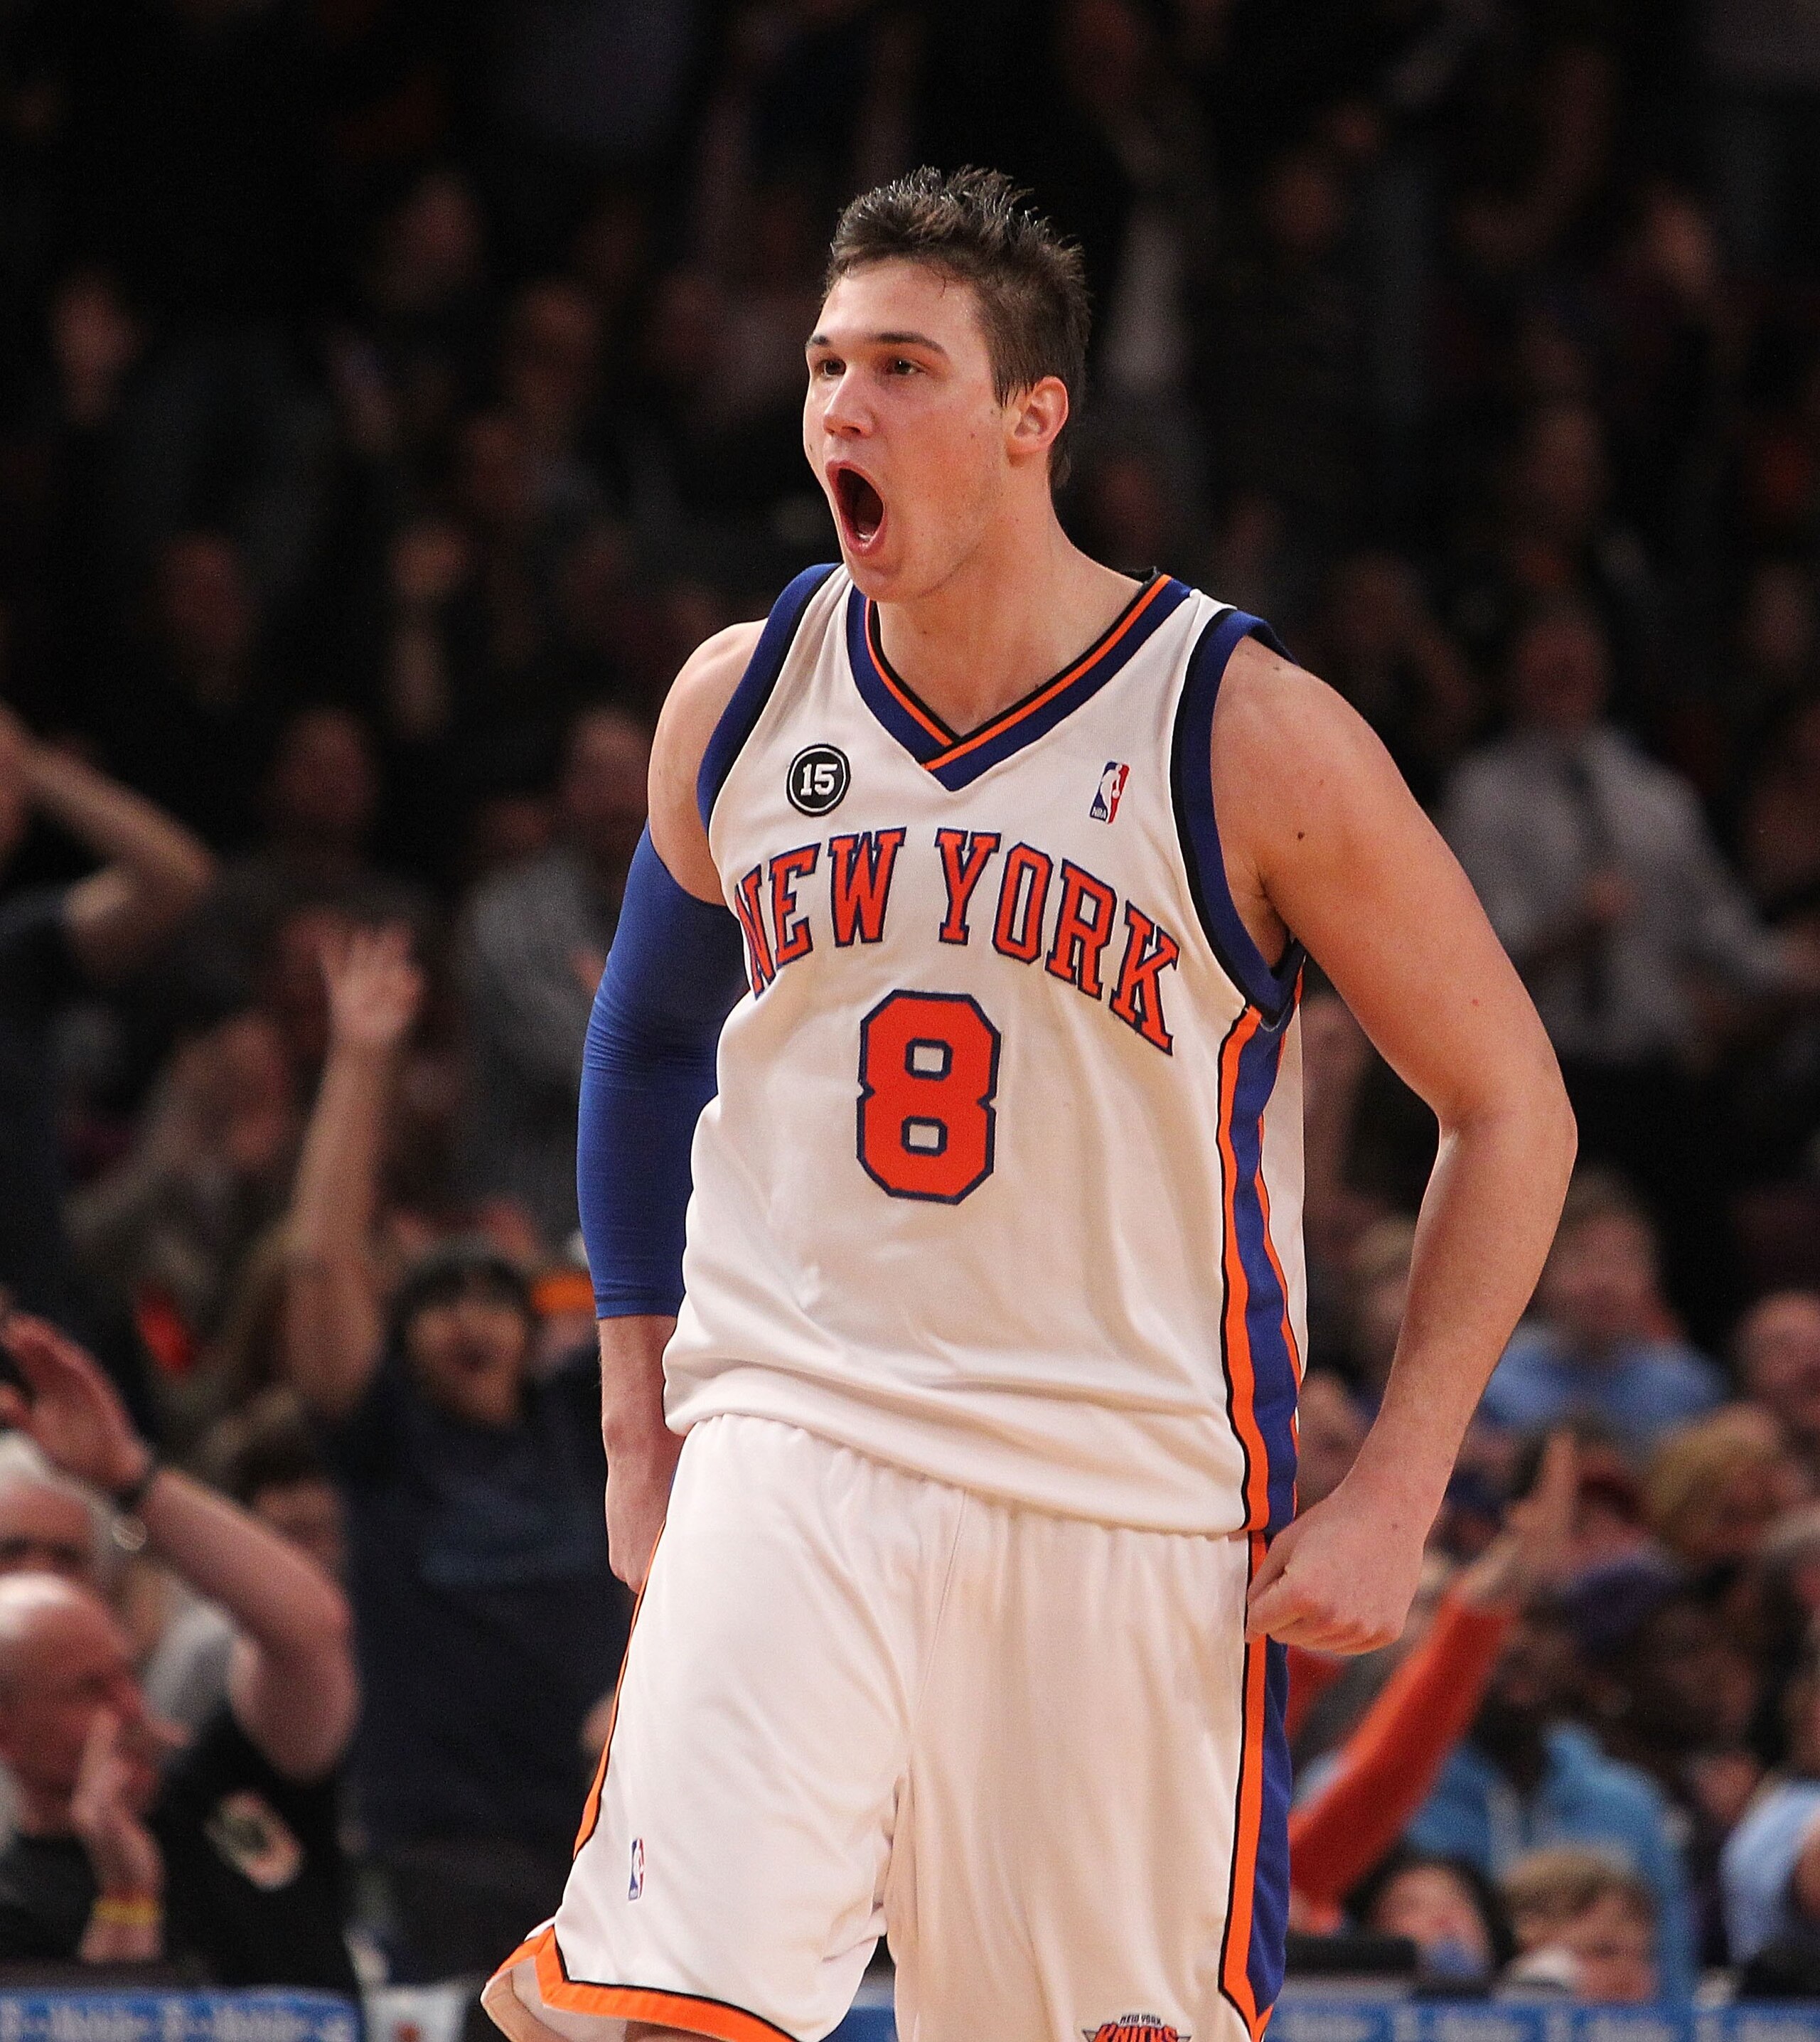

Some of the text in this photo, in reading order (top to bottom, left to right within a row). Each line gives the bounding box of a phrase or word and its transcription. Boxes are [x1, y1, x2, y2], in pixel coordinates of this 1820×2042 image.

[801, 763, 838, 796] 15
[735, 826, 1179, 1057] NEW YORK
[856, 990, 1001, 1205] 8
